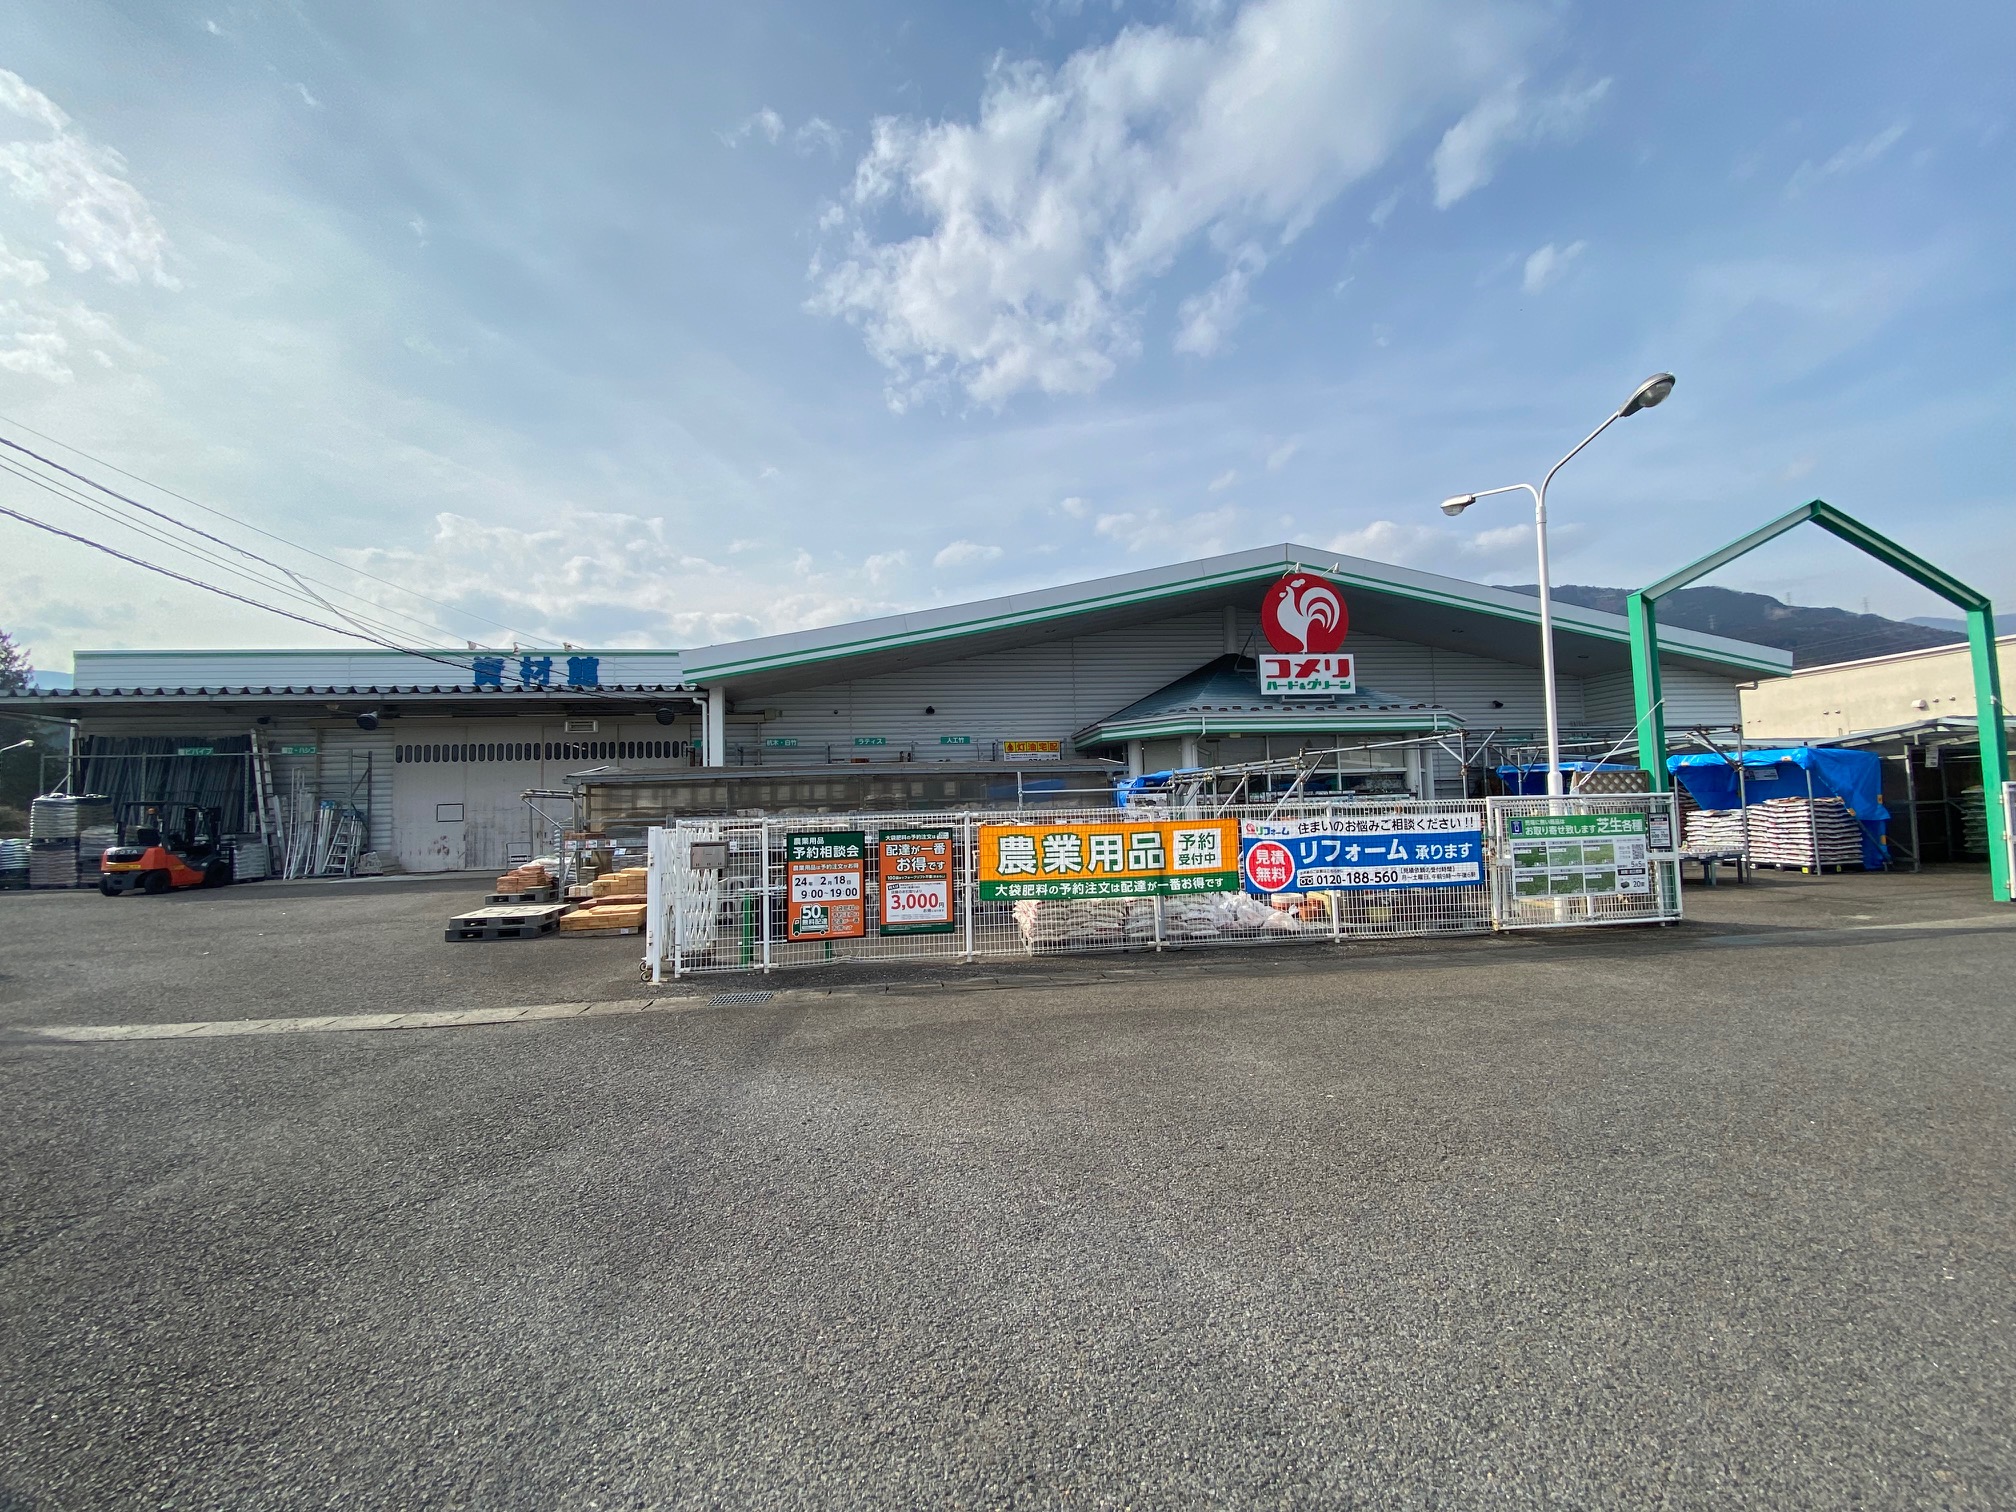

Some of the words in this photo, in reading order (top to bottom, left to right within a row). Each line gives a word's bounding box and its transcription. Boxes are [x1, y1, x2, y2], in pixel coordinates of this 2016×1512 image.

[473, 656, 599, 687] 資材館
[1265, 658, 1350, 679] コメリ
[1298, 816, 1474, 834] 住まいのお悩みご相談ください!!
[1524, 825, 1596, 836] お取り寄せ致します
[1596, 817, 1644, 834] 芝生各種
[793, 836, 825, 845] 農業用品
[885, 842, 946, 856] 配達が一番
[1178, 832, 1215, 851] 予約
[792, 844, 859, 859] 予約相談会
[996, 831, 1166, 876] 農業用品
[1178, 851, 1216, 866] 受付中
[1256, 849, 1286, 865] 見積
[1300, 838, 1409, 863] リフォーム
[1415, 842, 1473, 860] 承ります
[896, 857, 946, 872] お得です
[1256, 866, 1286, 883] 無料
[1317, 870, 1399, 885] 0120-188-560
[995, 877, 1224, 898] 大袋肥料の予約注文は配達が一番お得です
[890, 892, 945, 910] 3,000円
